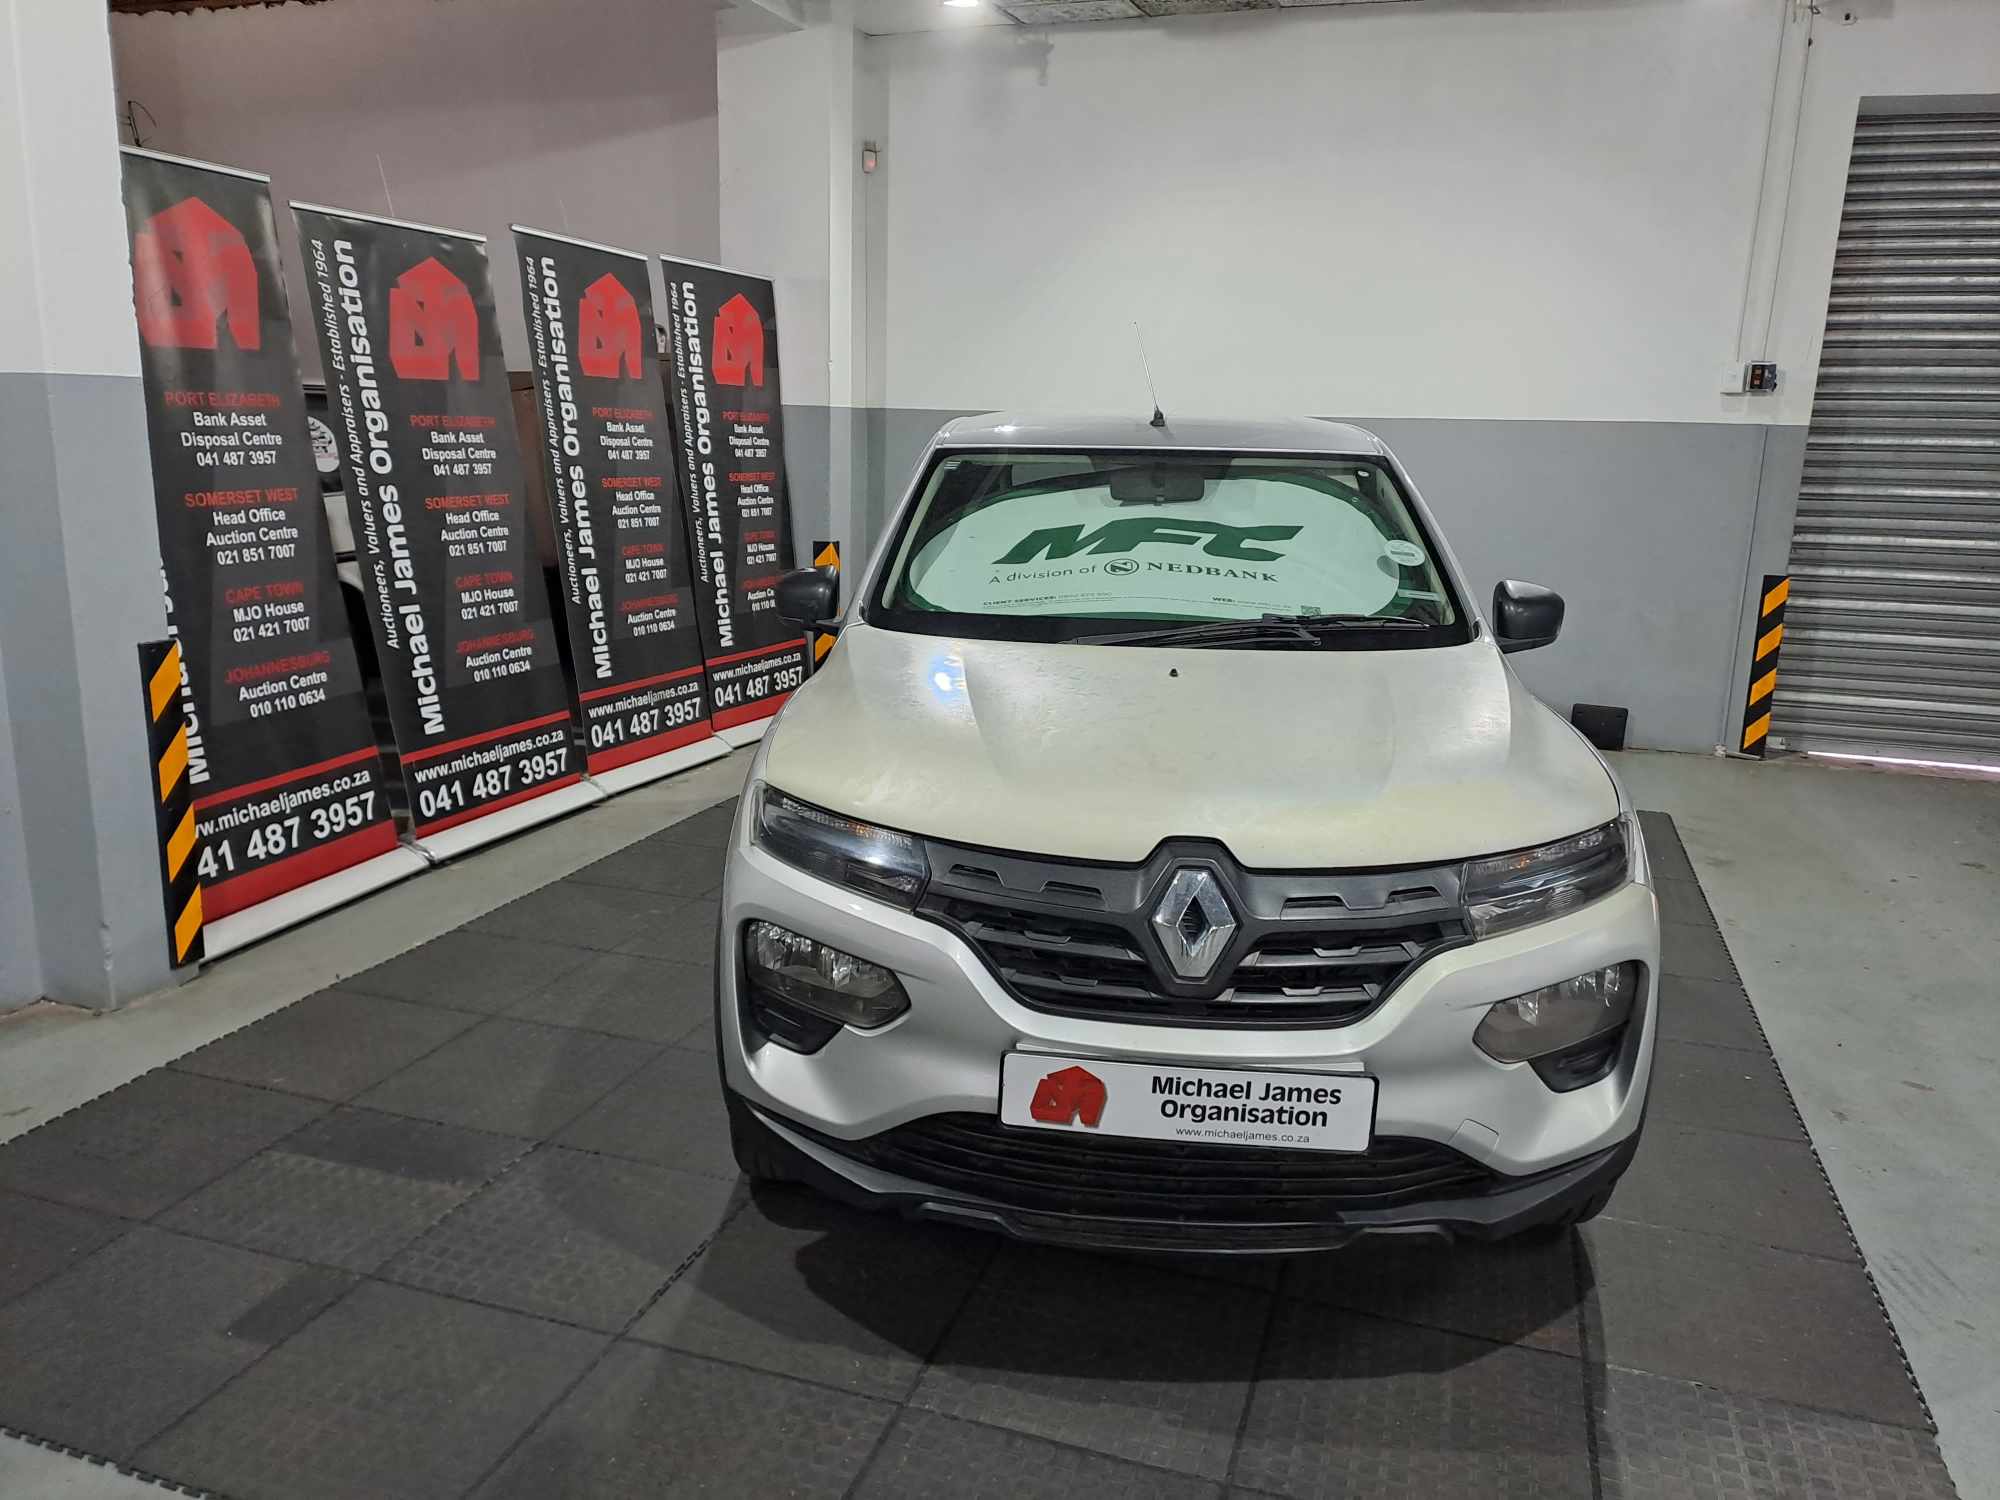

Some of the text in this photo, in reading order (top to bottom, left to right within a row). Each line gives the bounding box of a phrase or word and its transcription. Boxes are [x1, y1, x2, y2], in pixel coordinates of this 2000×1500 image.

[193, 411, 268, 427] Bank Asset
[180, 431, 283, 449] Disposal Centre
[430, 431, 485, 444] Bank Asset
[525, 256, 582, 605] Auctioneers, Valuers and Appraisers Established 1964
[670, 282, 710, 583] Auctioneers, Valuers and Appraisers Established 1964
[311, 238, 401, 649] Auctioneers, Valuers and Appraisers Established 1964
[600, 435, 631, 448] Disposal
[196, 450, 277, 467] 041 487 3957
[421, 447, 497, 462] Disposal Centre
[682, 281, 734, 648] Michael James Organisation
[433, 463, 492, 476] 041 487 3957
[541, 256, 612, 680] Michael James Organisation
[184, 487, 299, 508] SOMERSET WEST
[334, 238, 447, 736] Michael James Organisation
[616, 490, 655, 502] Head Office
[212, 508, 286, 526] Head Office
[445, 509, 500, 525] Head Office
[612, 504, 661, 515] Auction Centre
[441, 525, 509, 542] Auction Centre
[617, 518, 630, 529] 021
[631, 517, 643, 528] 851
[206, 526, 299, 547] Auction Centre
[217, 543, 296, 565] 021 851 7007
[449, 540, 507, 557] 021 851 7007
[641, 557, 665, 568] House
[1147, 561, 1280, 583] NEDBANK
[988, 565, 1096, 584] A division of
[461, 587, 515, 604] MJO House
[233, 601, 305, 623] MJO House
[461, 600, 519, 620] 021 421 7007
[627, 608, 676, 624] Auction Centre
[233, 616, 311, 643] 021 421 7007
[465, 645, 533, 668] Auction Centre
[473, 660, 531, 683] 010 110 0634
[238, 670, 328, 702] Auction Centre
[714, 666, 803, 707] 041 487 3957
[250, 688, 326, 718] 010 110 0634
[587, 681, 698, 718] www.michaeljames.co.za
[591, 697, 701, 748] 041 487 3957
[414, 729, 564, 783] www.michaeljames.co.za
[419, 747, 568, 818] 041 487 3957
[247, 815, 301, 861] 487
[310, 790, 375, 839] 3957
[1151, 1075, 1343, 1105] Michael James
[1160, 1099, 1328, 1128] Organisation
[1175, 1126, 1311, 1144] www.michaeljames.co.za
